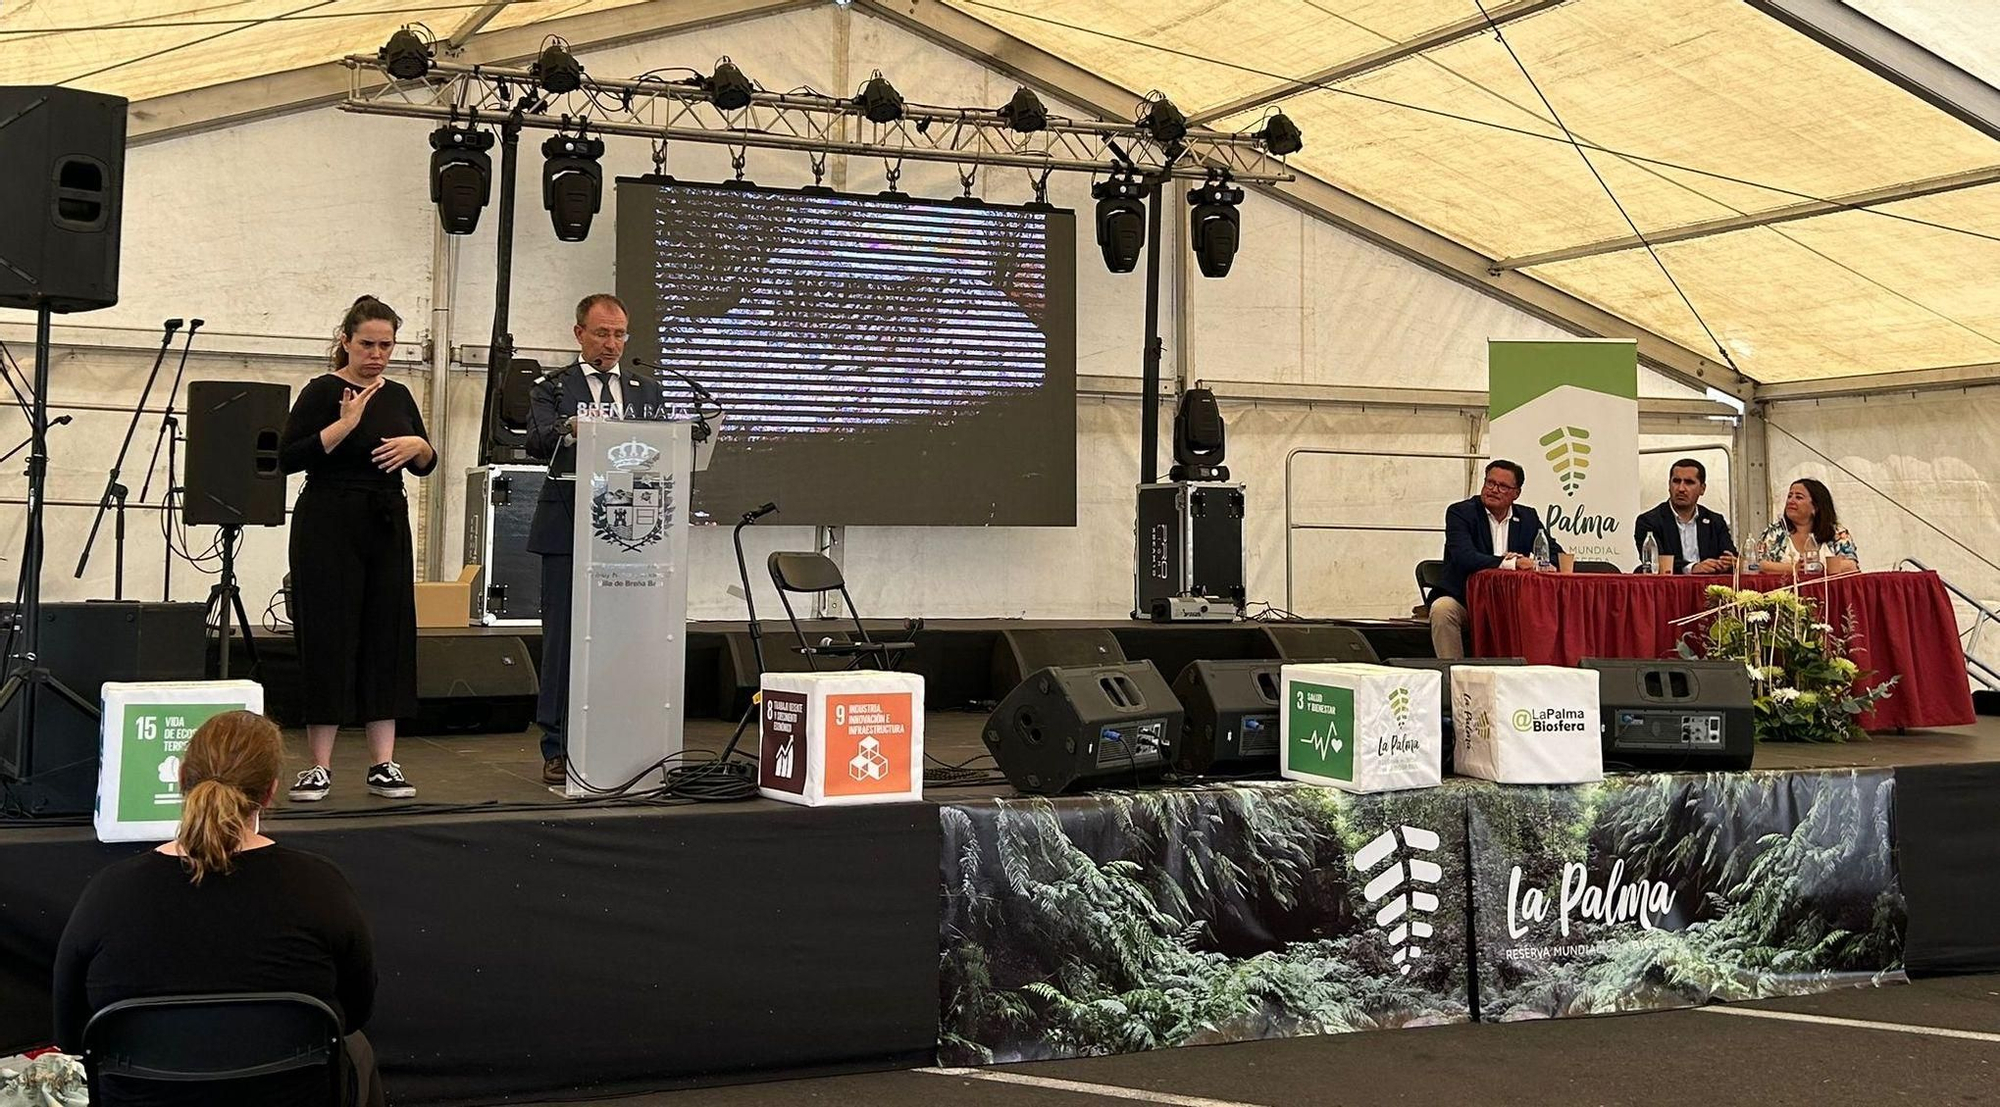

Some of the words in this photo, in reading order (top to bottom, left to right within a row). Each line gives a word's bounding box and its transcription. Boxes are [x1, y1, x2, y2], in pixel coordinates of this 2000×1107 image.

[1546, 504, 1620, 539] Palma
[1569, 546, 1620, 555] MUNDIAL
[1296, 691, 1304, 710] 3
[767, 699, 774, 721] 8
[836, 704, 846, 726] 9
[885, 713, 891, 723] E
[135, 716, 157, 740] 15
[165, 716, 185, 727] VIDA
[848, 724, 905, 735] INFRAESTRUCTURA
[1533, 720, 1585, 732] Biosfera
[164, 729, 175, 739] DE
[1378, 736, 1388, 756] La
[1391, 733, 1419, 755] Palma
[1507, 865, 1551, 939] La
[1560, 858, 1677, 937] Palma
[1505, 946, 1550, 960] RESERVA
[1553, 944, 1600, 957] MUNDIAL
